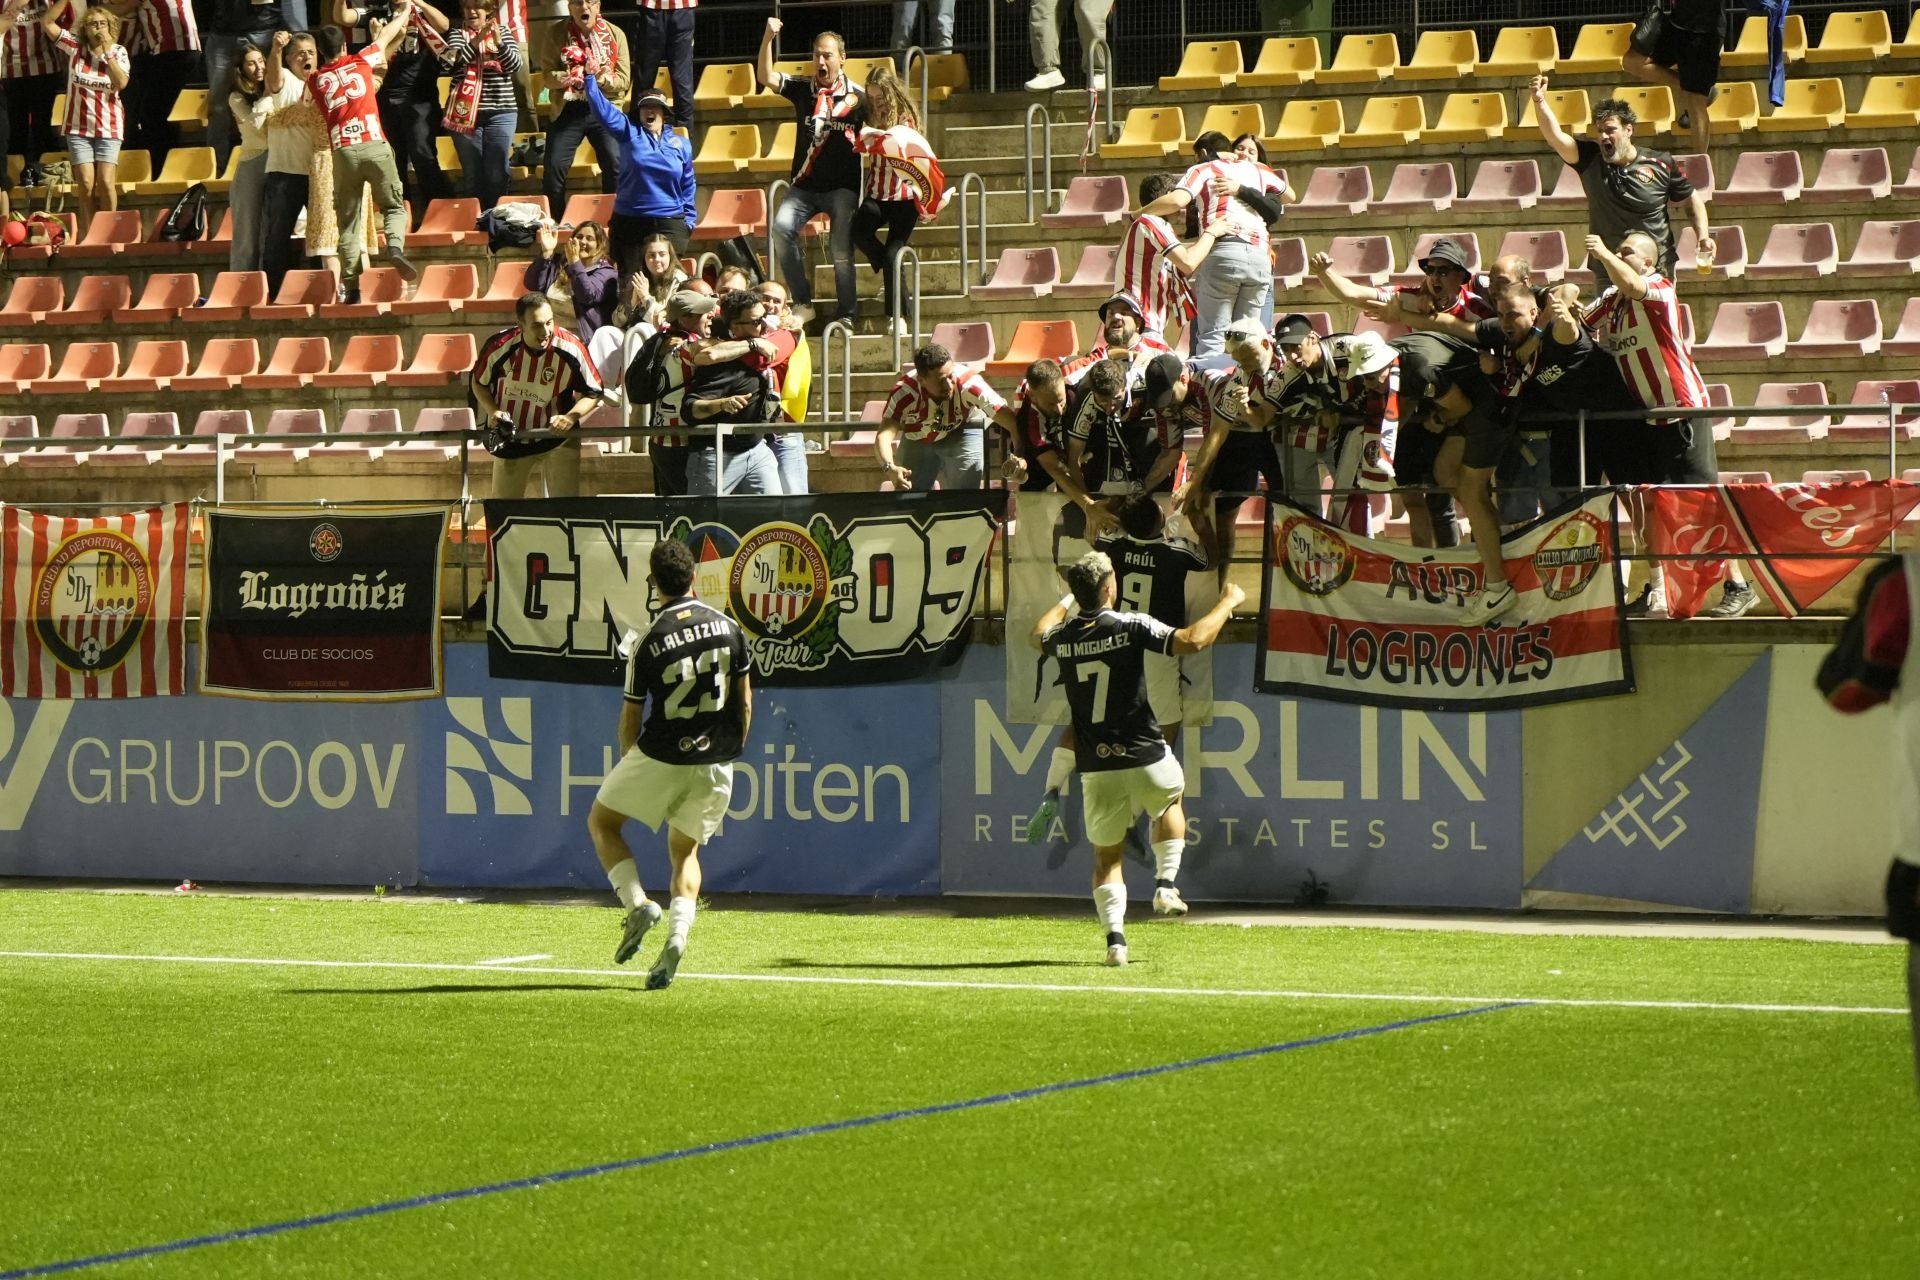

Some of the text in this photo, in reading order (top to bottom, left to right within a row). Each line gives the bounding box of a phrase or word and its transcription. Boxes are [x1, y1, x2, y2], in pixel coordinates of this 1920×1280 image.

[317, 62, 366, 112] 25
[732, 531, 825, 590] SOCIEDAD DEPORTIVA LOGROÑÉS
[1125, 551, 1156, 568] RAÚL
[1292, 531, 1313, 561] SDL
[40, 536, 148, 606] SOCIEDAD DEPORTIVA LOGROÑÉS
[66, 565, 95, 614] SDL
[239, 569, 406, 618] Logroñés
[753, 553, 777, 594] SDL
[1120, 572, 1153, 613] 9
[1386, 555, 1478, 608] AÚP
[262, 648, 374, 660] CLUB DE SOCIOS
[755, 637, 813, 672] Tour
[1074, 632, 1131, 657] MIGUELEZ
[1326, 617, 1553, 687] LOGROÑÉS
[662, 647, 731, 720] 23
[1076, 660, 1111, 724] 7
[974, 699, 1487, 801] MRLIN
[560, 743, 910, 837] Hpiten
[975, 814, 1070, 843] REA
[1431, 820, 1488, 850] SL
